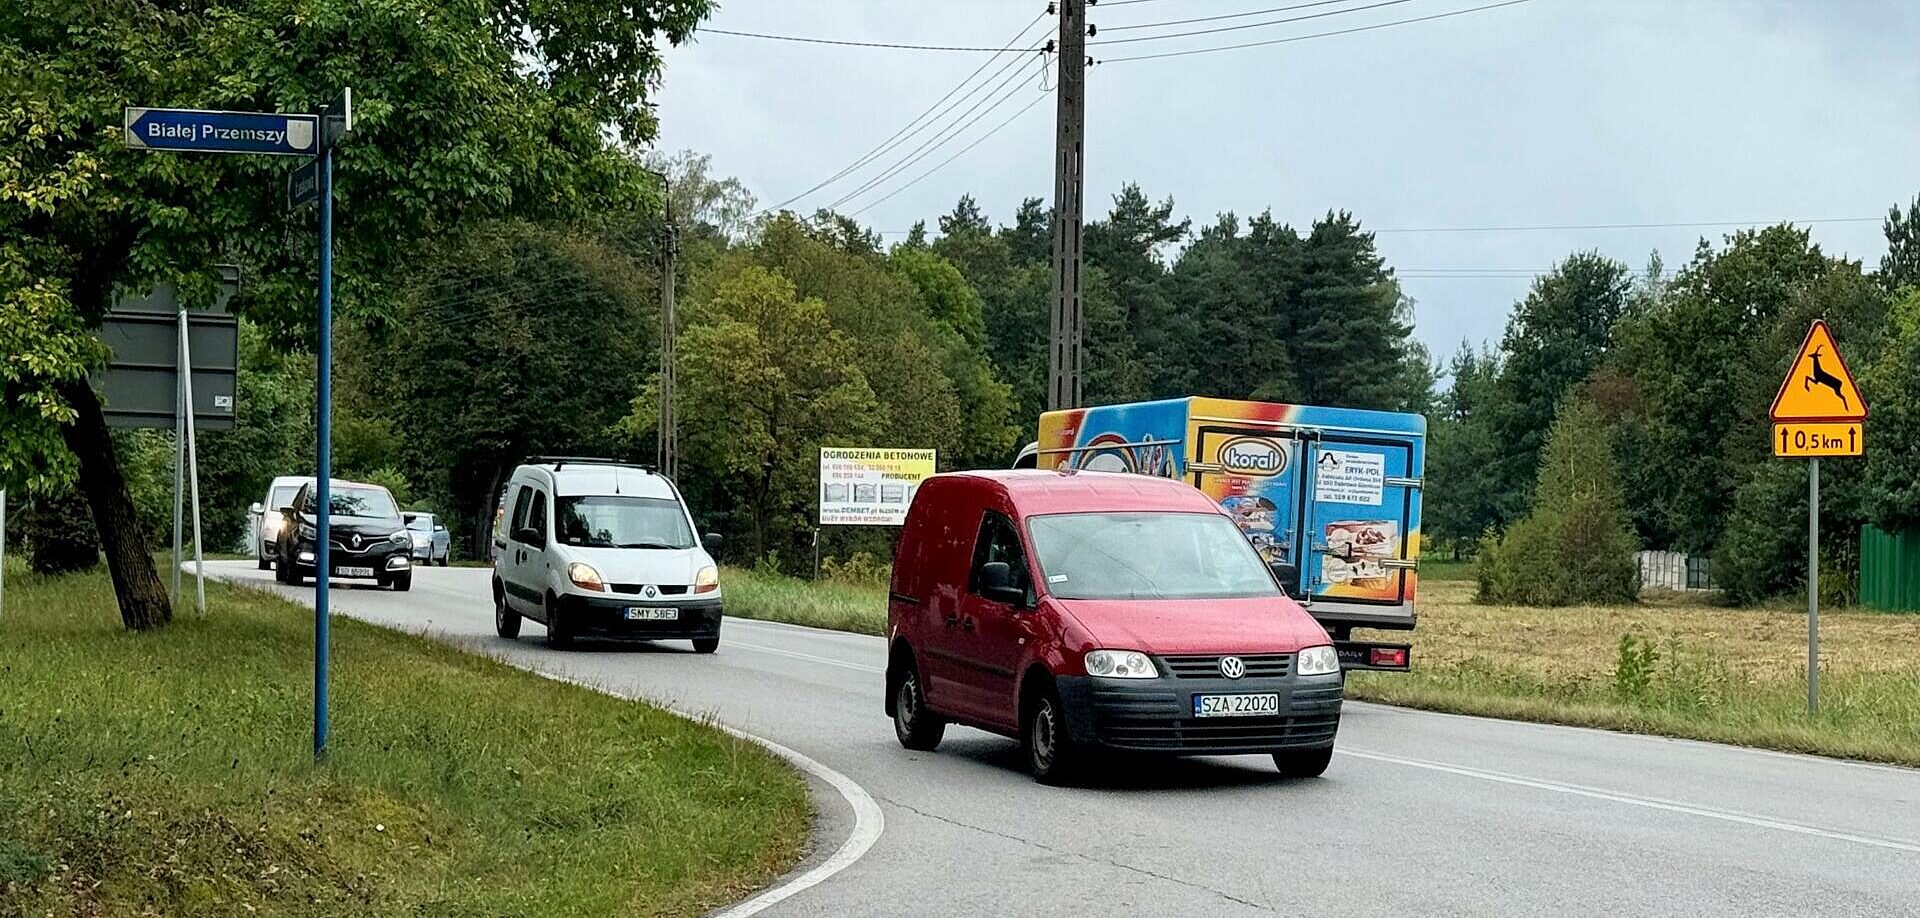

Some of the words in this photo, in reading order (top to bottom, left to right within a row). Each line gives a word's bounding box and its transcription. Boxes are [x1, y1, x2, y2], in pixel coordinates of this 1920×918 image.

[148, 123, 196, 142] Białej
[203, 124, 285, 145] Przemszy
[1795, 430, 1819, 451] 0,5
[1822, 434, 1843, 449] km
[823, 450, 881, 460] OGRODZENIA
[883, 451, 933, 461] BETONOWE
[1228, 447, 1276, 470] koral
[630, 609, 651, 618] SMY
[1339, 650, 1363, 658] DAILY
[1202, 696, 1230, 712] SZA
[1235, 695, 1277, 711] 22020
